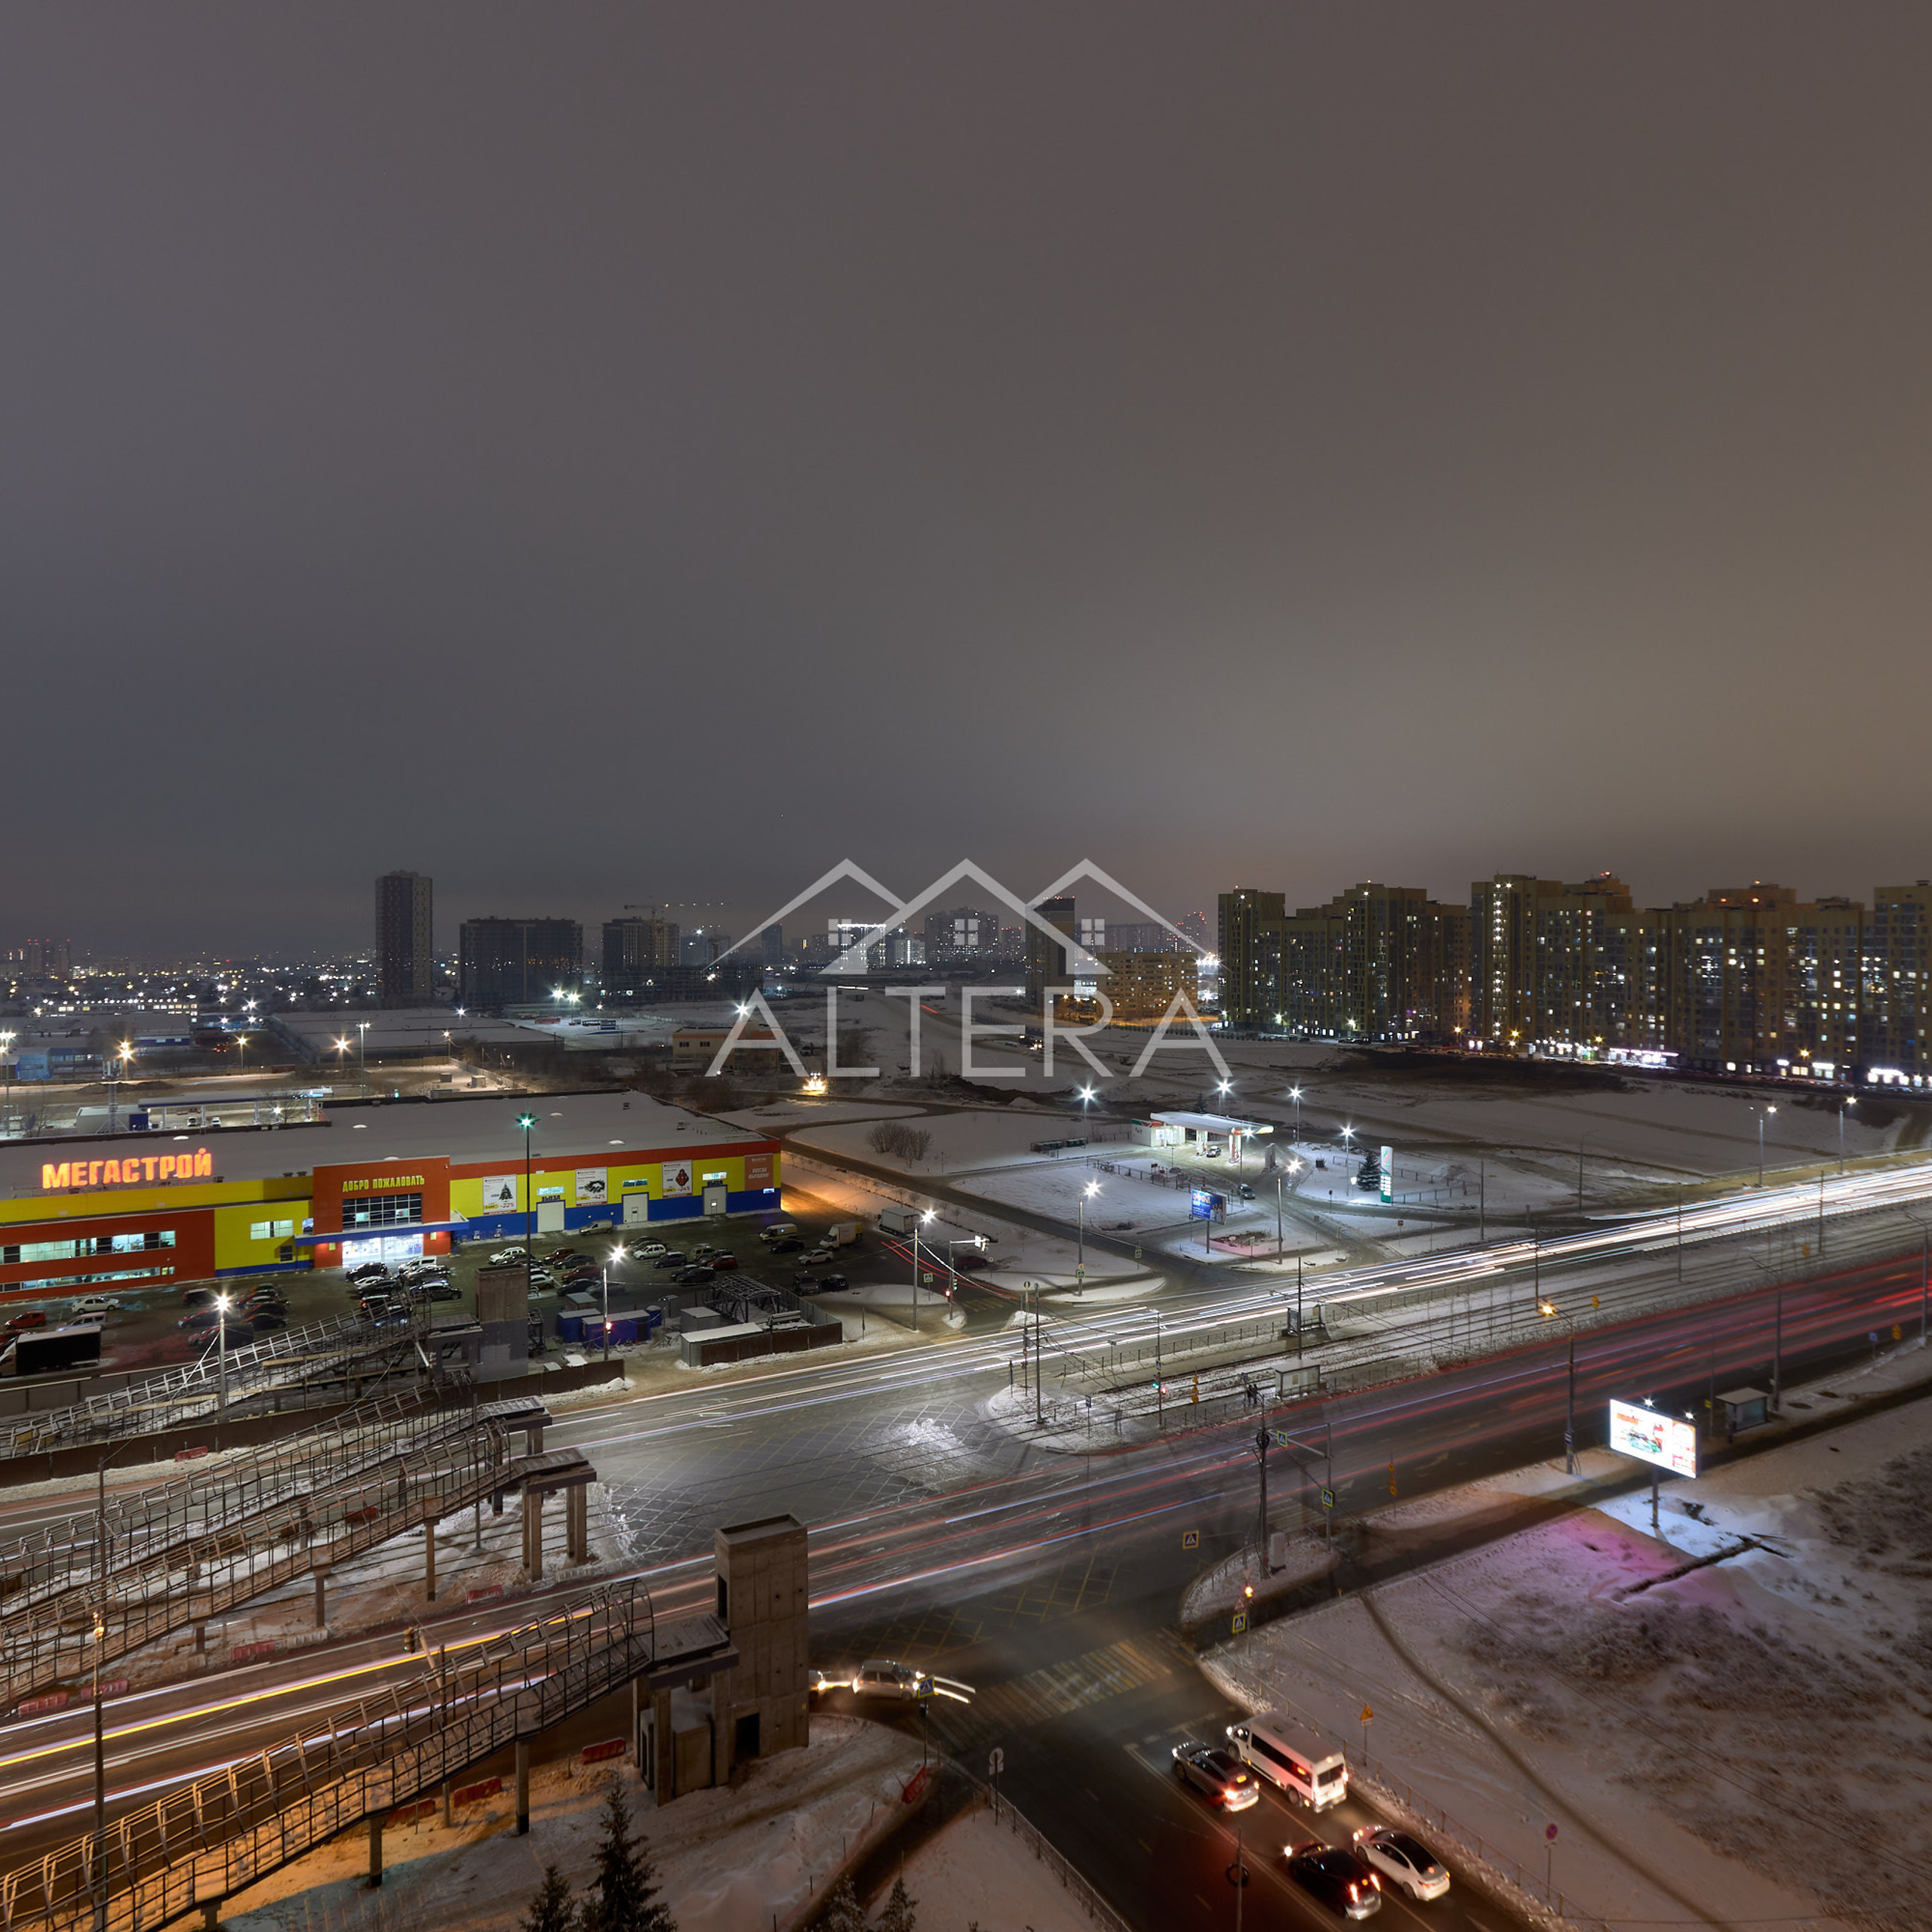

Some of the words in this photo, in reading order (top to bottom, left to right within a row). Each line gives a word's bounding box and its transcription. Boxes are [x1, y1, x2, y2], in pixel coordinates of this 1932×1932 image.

[42, 1147, 212, 1189] МЕГАСТРОЙ
[342, 1180, 369, 1192] ДОБРО
[372, 1175, 425, 1189] ПОЖАЛОВАТЬ
